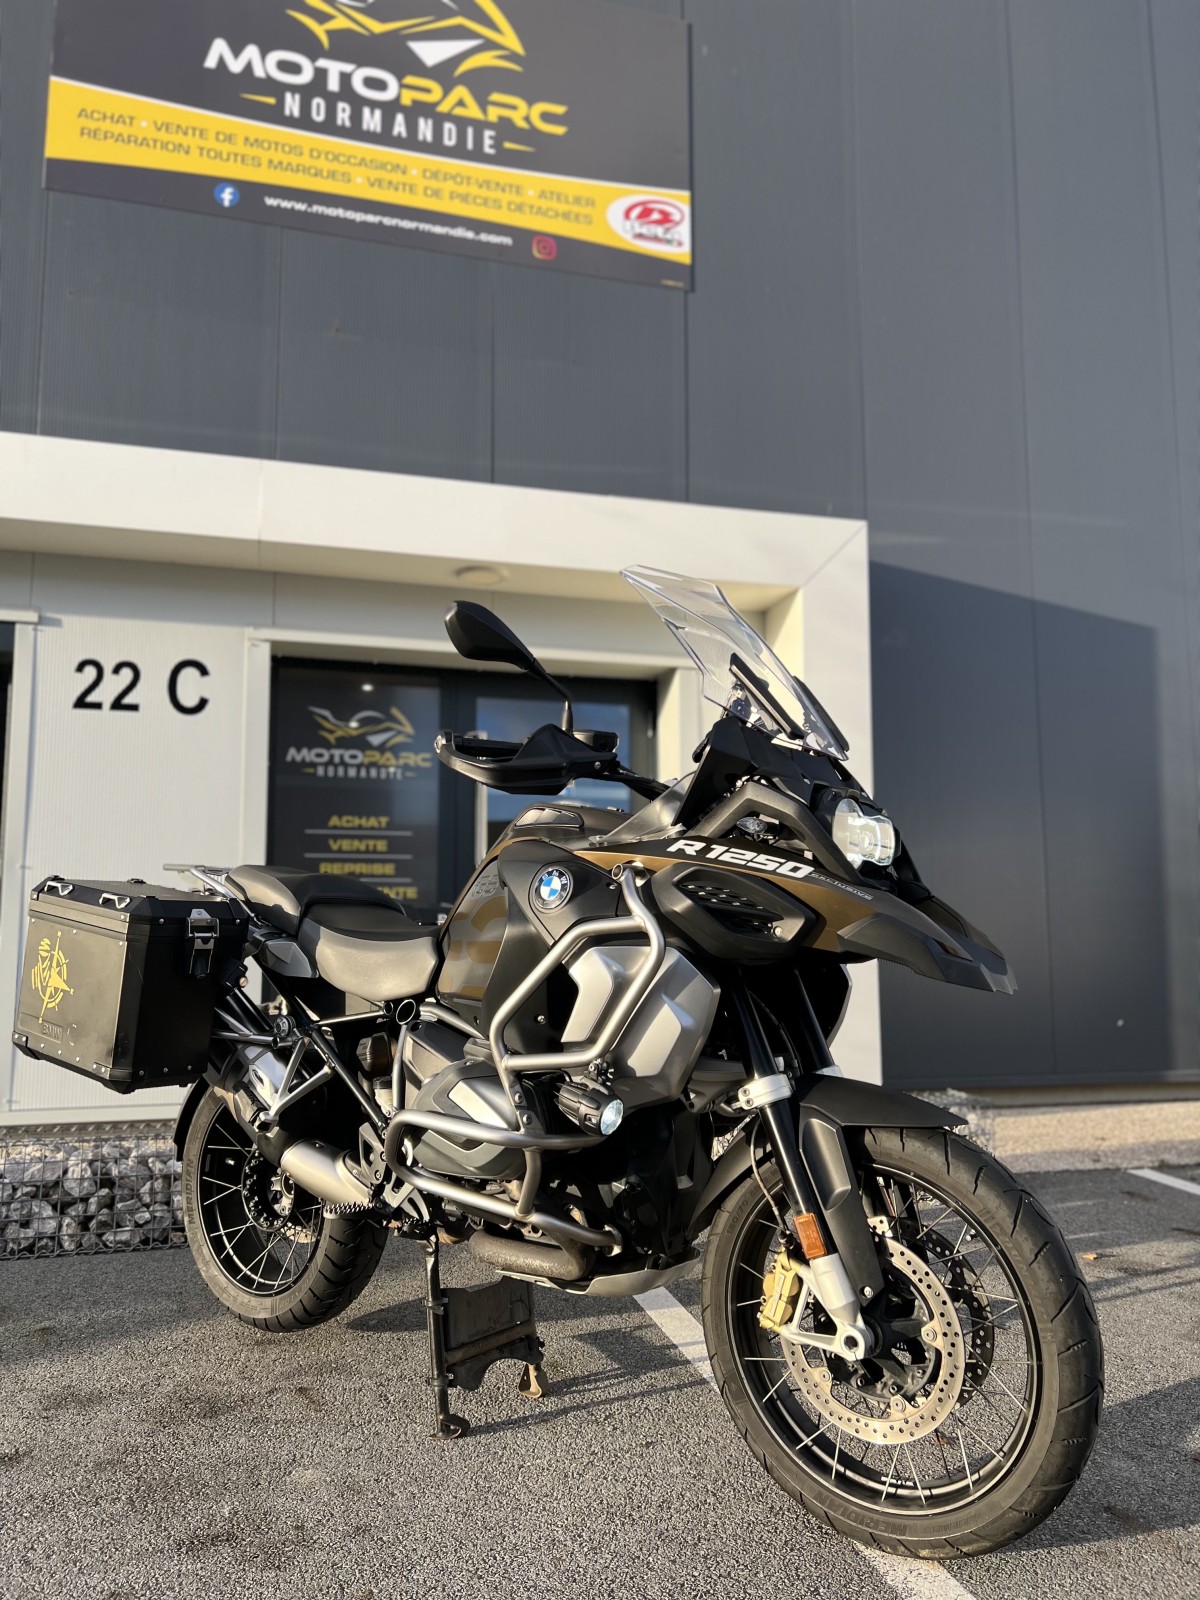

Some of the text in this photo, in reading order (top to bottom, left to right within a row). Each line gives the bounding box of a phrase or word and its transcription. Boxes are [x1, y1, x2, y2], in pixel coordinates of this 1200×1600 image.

[203, 38, 569, 136] MOTOPARC
[284, 91, 496, 154] NORMANDIE
[77, 107, 596, 209] ACHAT VENTE DE MOTOS D'OCCASION DÉPÔT-VENTE ATELIER
[79, 126, 191, 156] RÉPARATION
[196, 145, 263, 168] TOUTES
[267, 158, 353, 184] MARQUES
[367, 176, 418, 196] VENTE
[423, 186, 445, 201] DE
[507, 199, 594, 226] DÉTACHÉES
[263, 196, 513, 246] www.motoparcnormandie.com
[72, 658, 210, 715] 22 C
[285, 747, 433, 768] MOTOPARC
[316, 765, 404, 780] NORMANDIE
[328, 814, 390, 828] ACHAT
[328, 838, 388, 852] VENTE
[666, 839, 815, 878] R 1250
[319, 861, 396, 876] REPRISE
